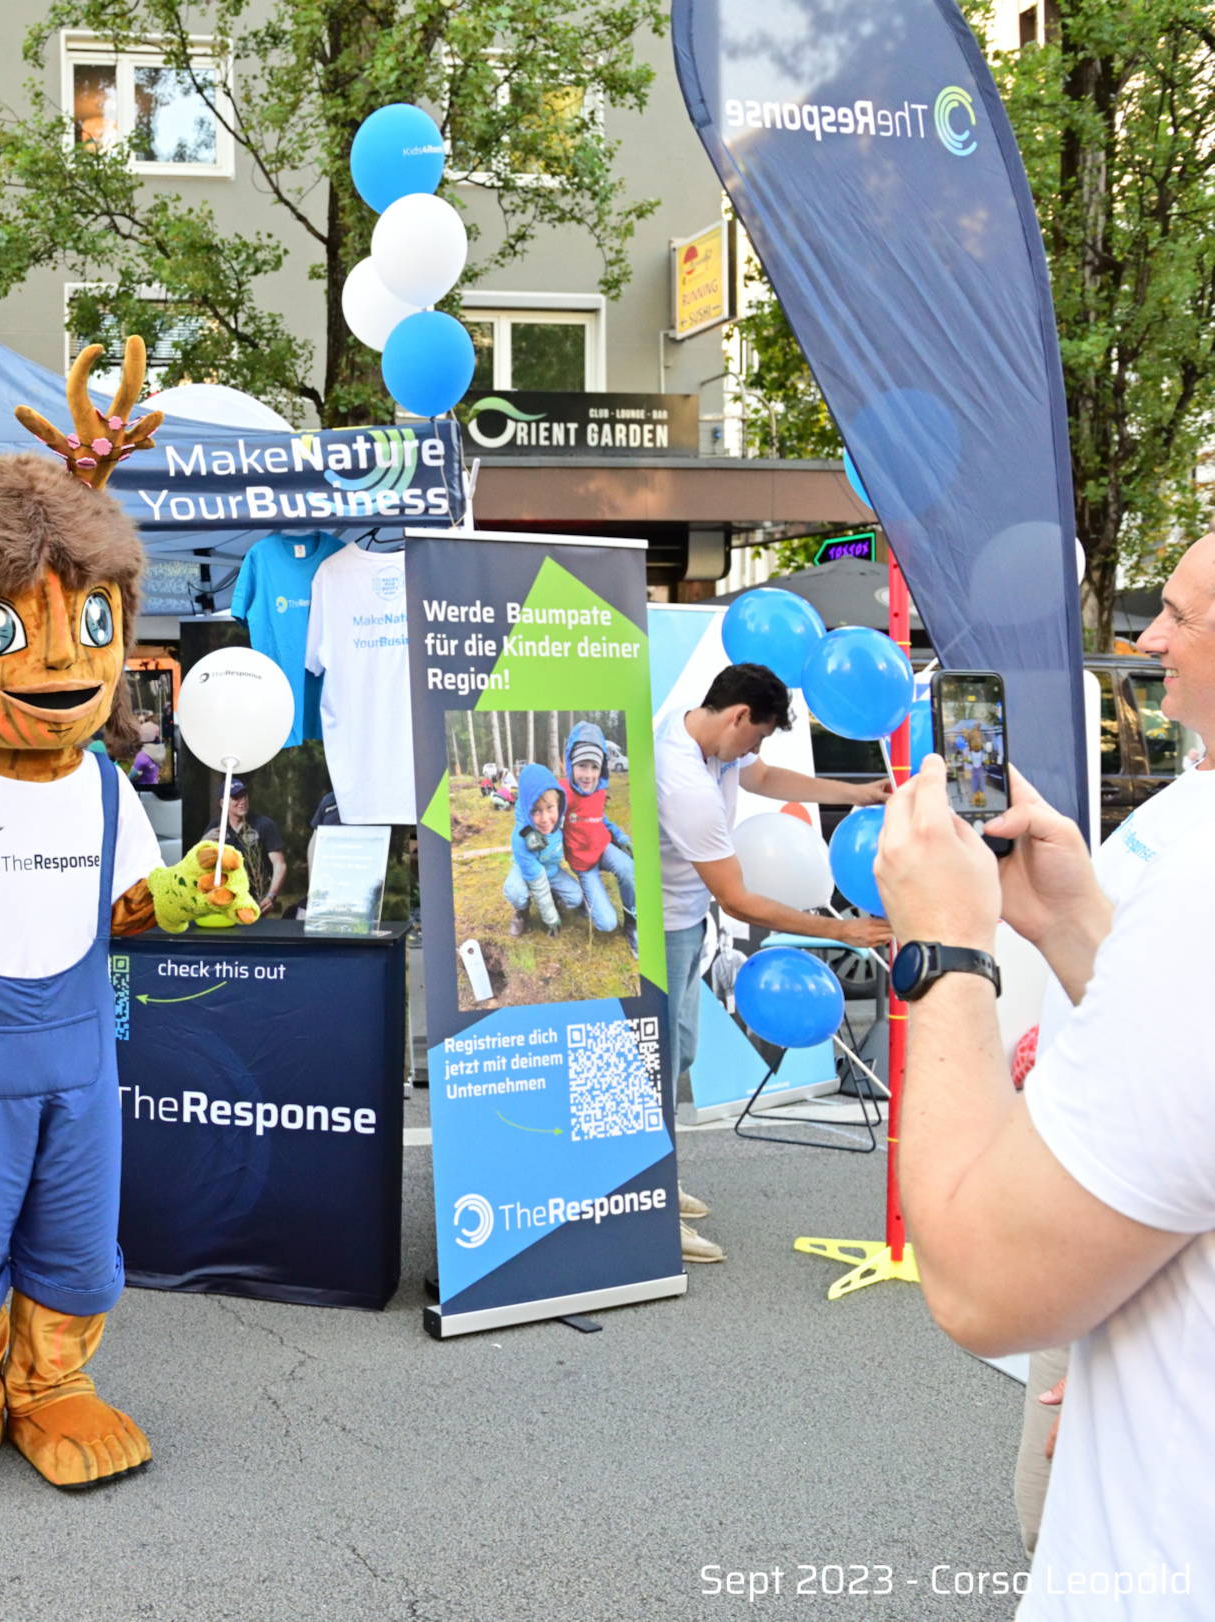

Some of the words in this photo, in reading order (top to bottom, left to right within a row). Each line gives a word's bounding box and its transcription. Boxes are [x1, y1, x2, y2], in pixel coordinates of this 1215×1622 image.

[689, 303, 711, 326] SUSHI
[589, 408, 609, 418] CLUB
[616, 409, 645, 419] LOUNGE
[652, 410, 668, 420] BAR
[587, 423, 668, 448] GARDEN
[165, 435, 445, 477] MakeNature
[138, 480, 449, 521] YourBusiness
[288, 599, 310, 608] TheRes
[423, 600, 495, 623] Werde
[506, 602, 611, 630] Baumpate
[424, 633, 459, 656] für
[464, 634, 497, 656] die
[503, 635, 571, 657] Kinder
[578, 636, 640, 658] deiner
[212, 669, 262, 680] TheResponse
[427, 667, 510, 695] Region!
[0, 854, 100, 873] TheResponse
[158, 959, 210, 977] check
[215, 961, 249, 978] this
[254, 964, 286, 979] out
[444, 1032, 525, 1055] Registriere
[529, 1028, 558, 1045] dich
[445, 1059, 479, 1080] jetzt
[483, 1055, 507, 1072] mit
[511, 1052, 563, 1070] deinem
[446, 1077, 546, 1100] Unternehmen
[498, 1188, 667, 1231] TheResponse
